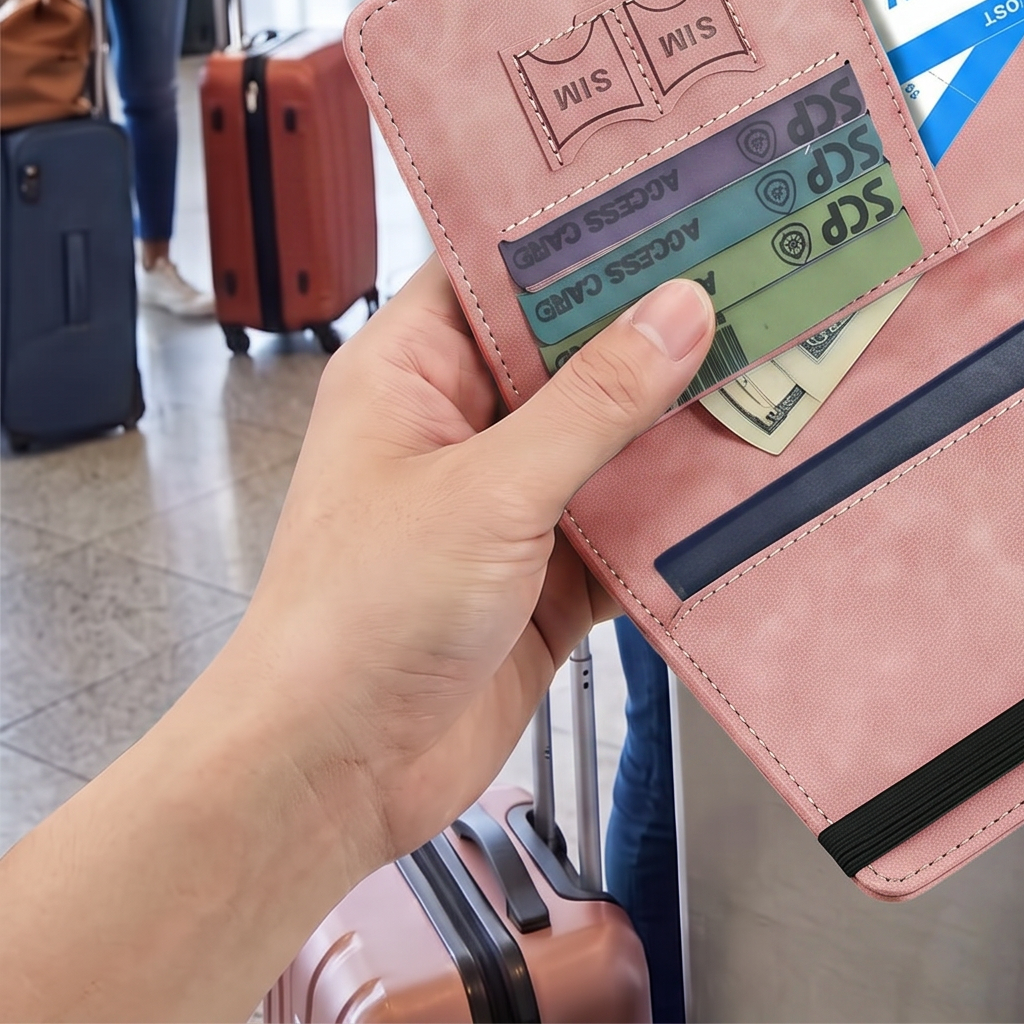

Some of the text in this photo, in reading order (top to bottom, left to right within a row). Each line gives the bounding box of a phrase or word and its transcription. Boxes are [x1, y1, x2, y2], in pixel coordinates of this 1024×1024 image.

[659, 15, 717, 59] SIM
[553, 68, 612, 112] SIM
[787, 76, 862, 145] SCP
[806, 123, 881, 195] SCP
[587, 168, 680, 233] ACCESS
[821, 176, 895, 246] SCP
[603, 217, 700, 286] ACCESS
